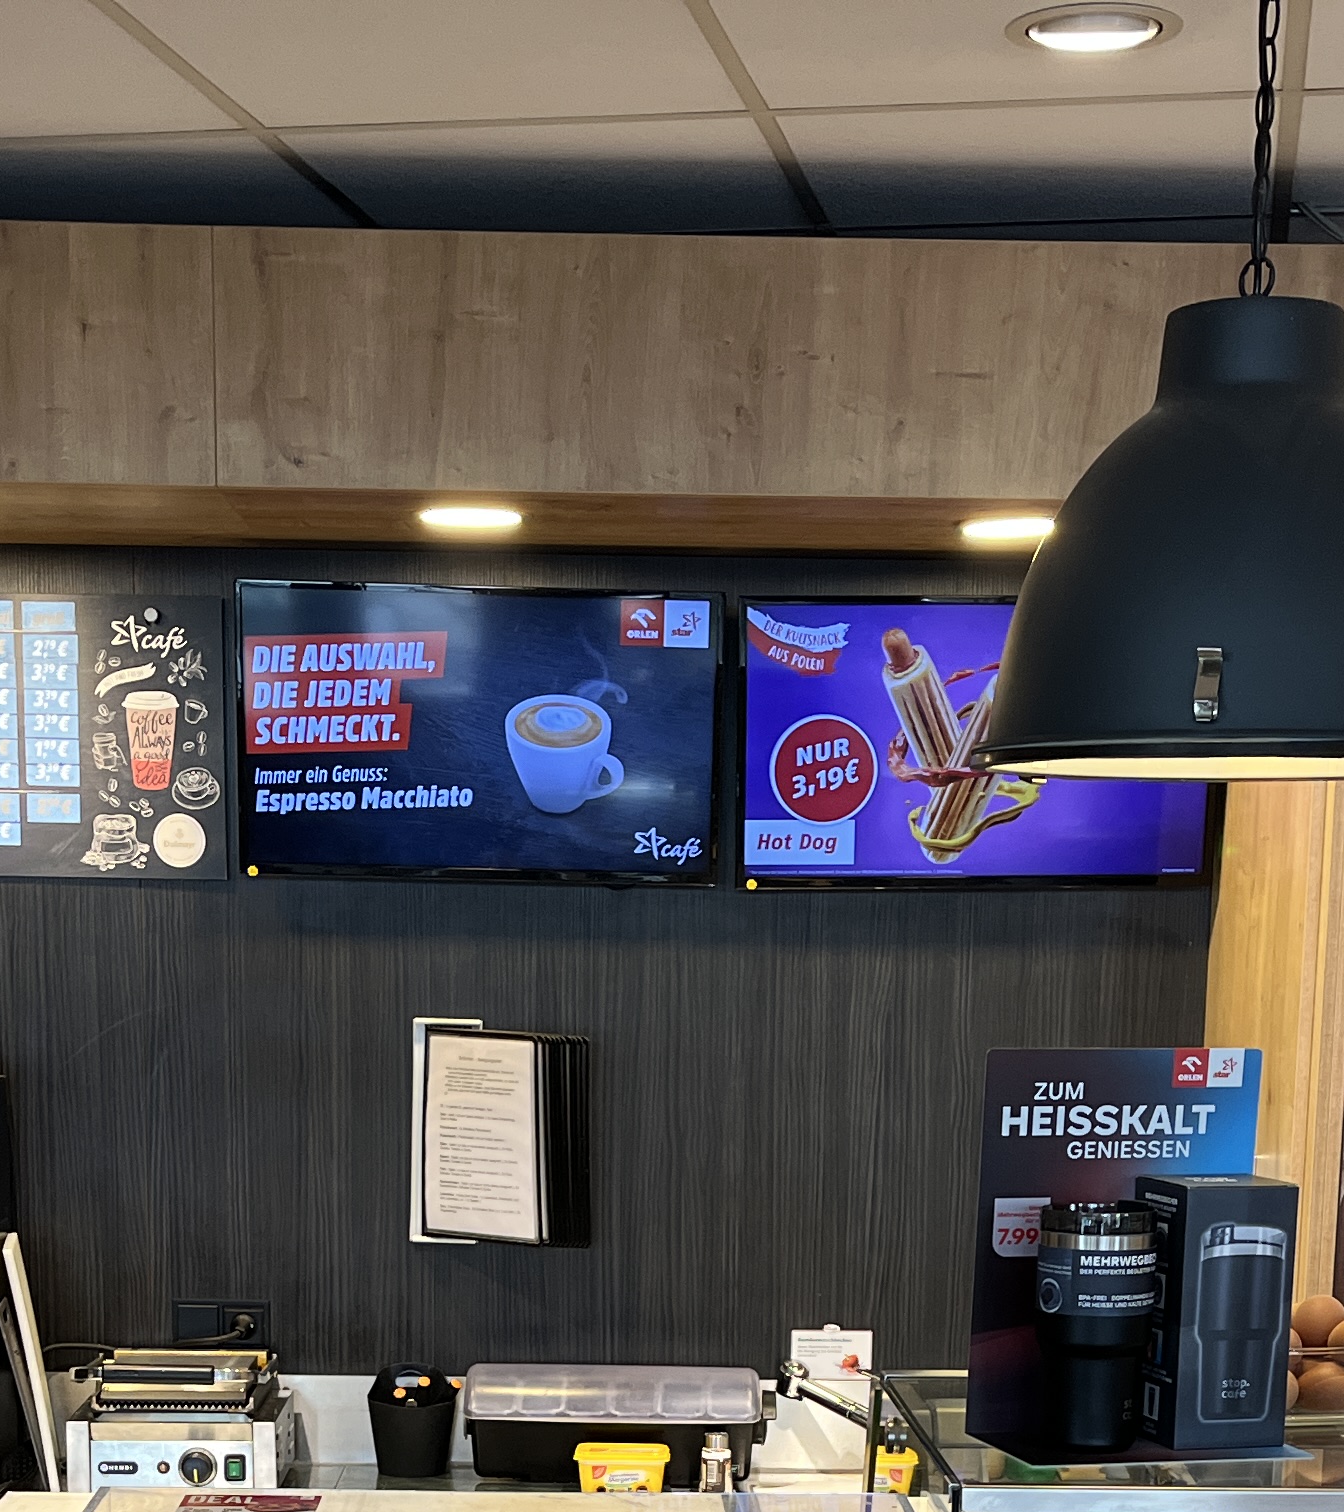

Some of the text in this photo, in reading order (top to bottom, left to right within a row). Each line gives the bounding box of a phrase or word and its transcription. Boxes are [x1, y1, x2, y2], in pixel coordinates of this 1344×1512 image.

[626, 629, 659, 639] ORLEN
[764, 619, 783, 636] DER
[142, 628, 187, 658] café
[253, 641, 436, 673] DIE AUSWAHL,
[768, 645, 824, 671] AUS POLEN
[253, 679, 391, 708] DIE JEDEM
[131, 710, 173, 739] coffee
[255, 715, 400, 745] SCHMECKT.
[796, 738, 850, 765] NUR
[255, 764, 388, 785] Immer ein Genuss:
[792, 759, 859, 799] 3,19€
[256, 785, 473, 814] Espresso Macchiato
[661, 837, 702, 865] café
[758, 834, 837, 855] Hot Dog
[1177, 1073, 1203, 1081] ORLEN
[1034, 1082, 1085, 1100] ZUM
[1001, 1105, 1216, 1137] HEISSKALT
[1067, 1140, 1190, 1159] GENIESSEN
[998, 1228, 1039, 1246] 7.99
[187, 1496, 255, 1504] DEAL
